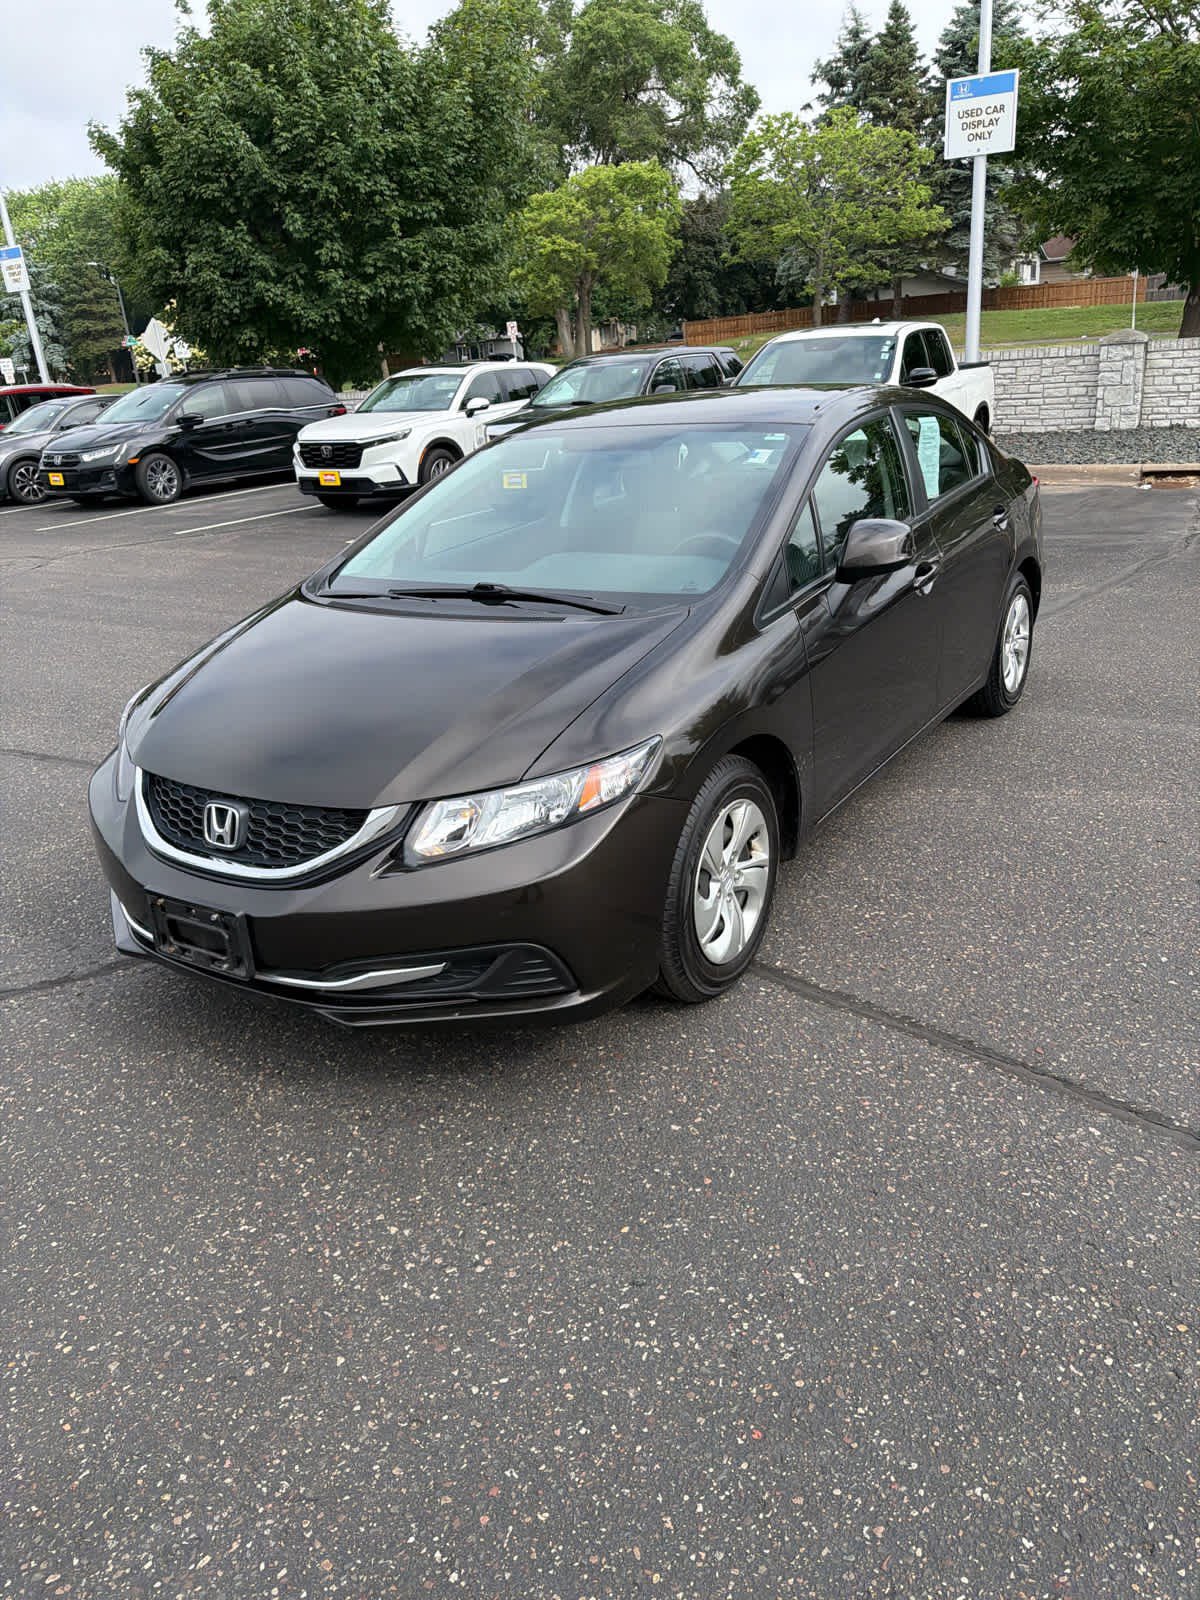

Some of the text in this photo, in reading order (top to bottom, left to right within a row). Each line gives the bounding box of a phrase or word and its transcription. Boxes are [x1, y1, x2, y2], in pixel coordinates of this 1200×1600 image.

[957, 104, 1005, 119] USED CAR
[961, 117, 1000, 131] DISPLAY
[967, 130, 993, 142] ONLY
